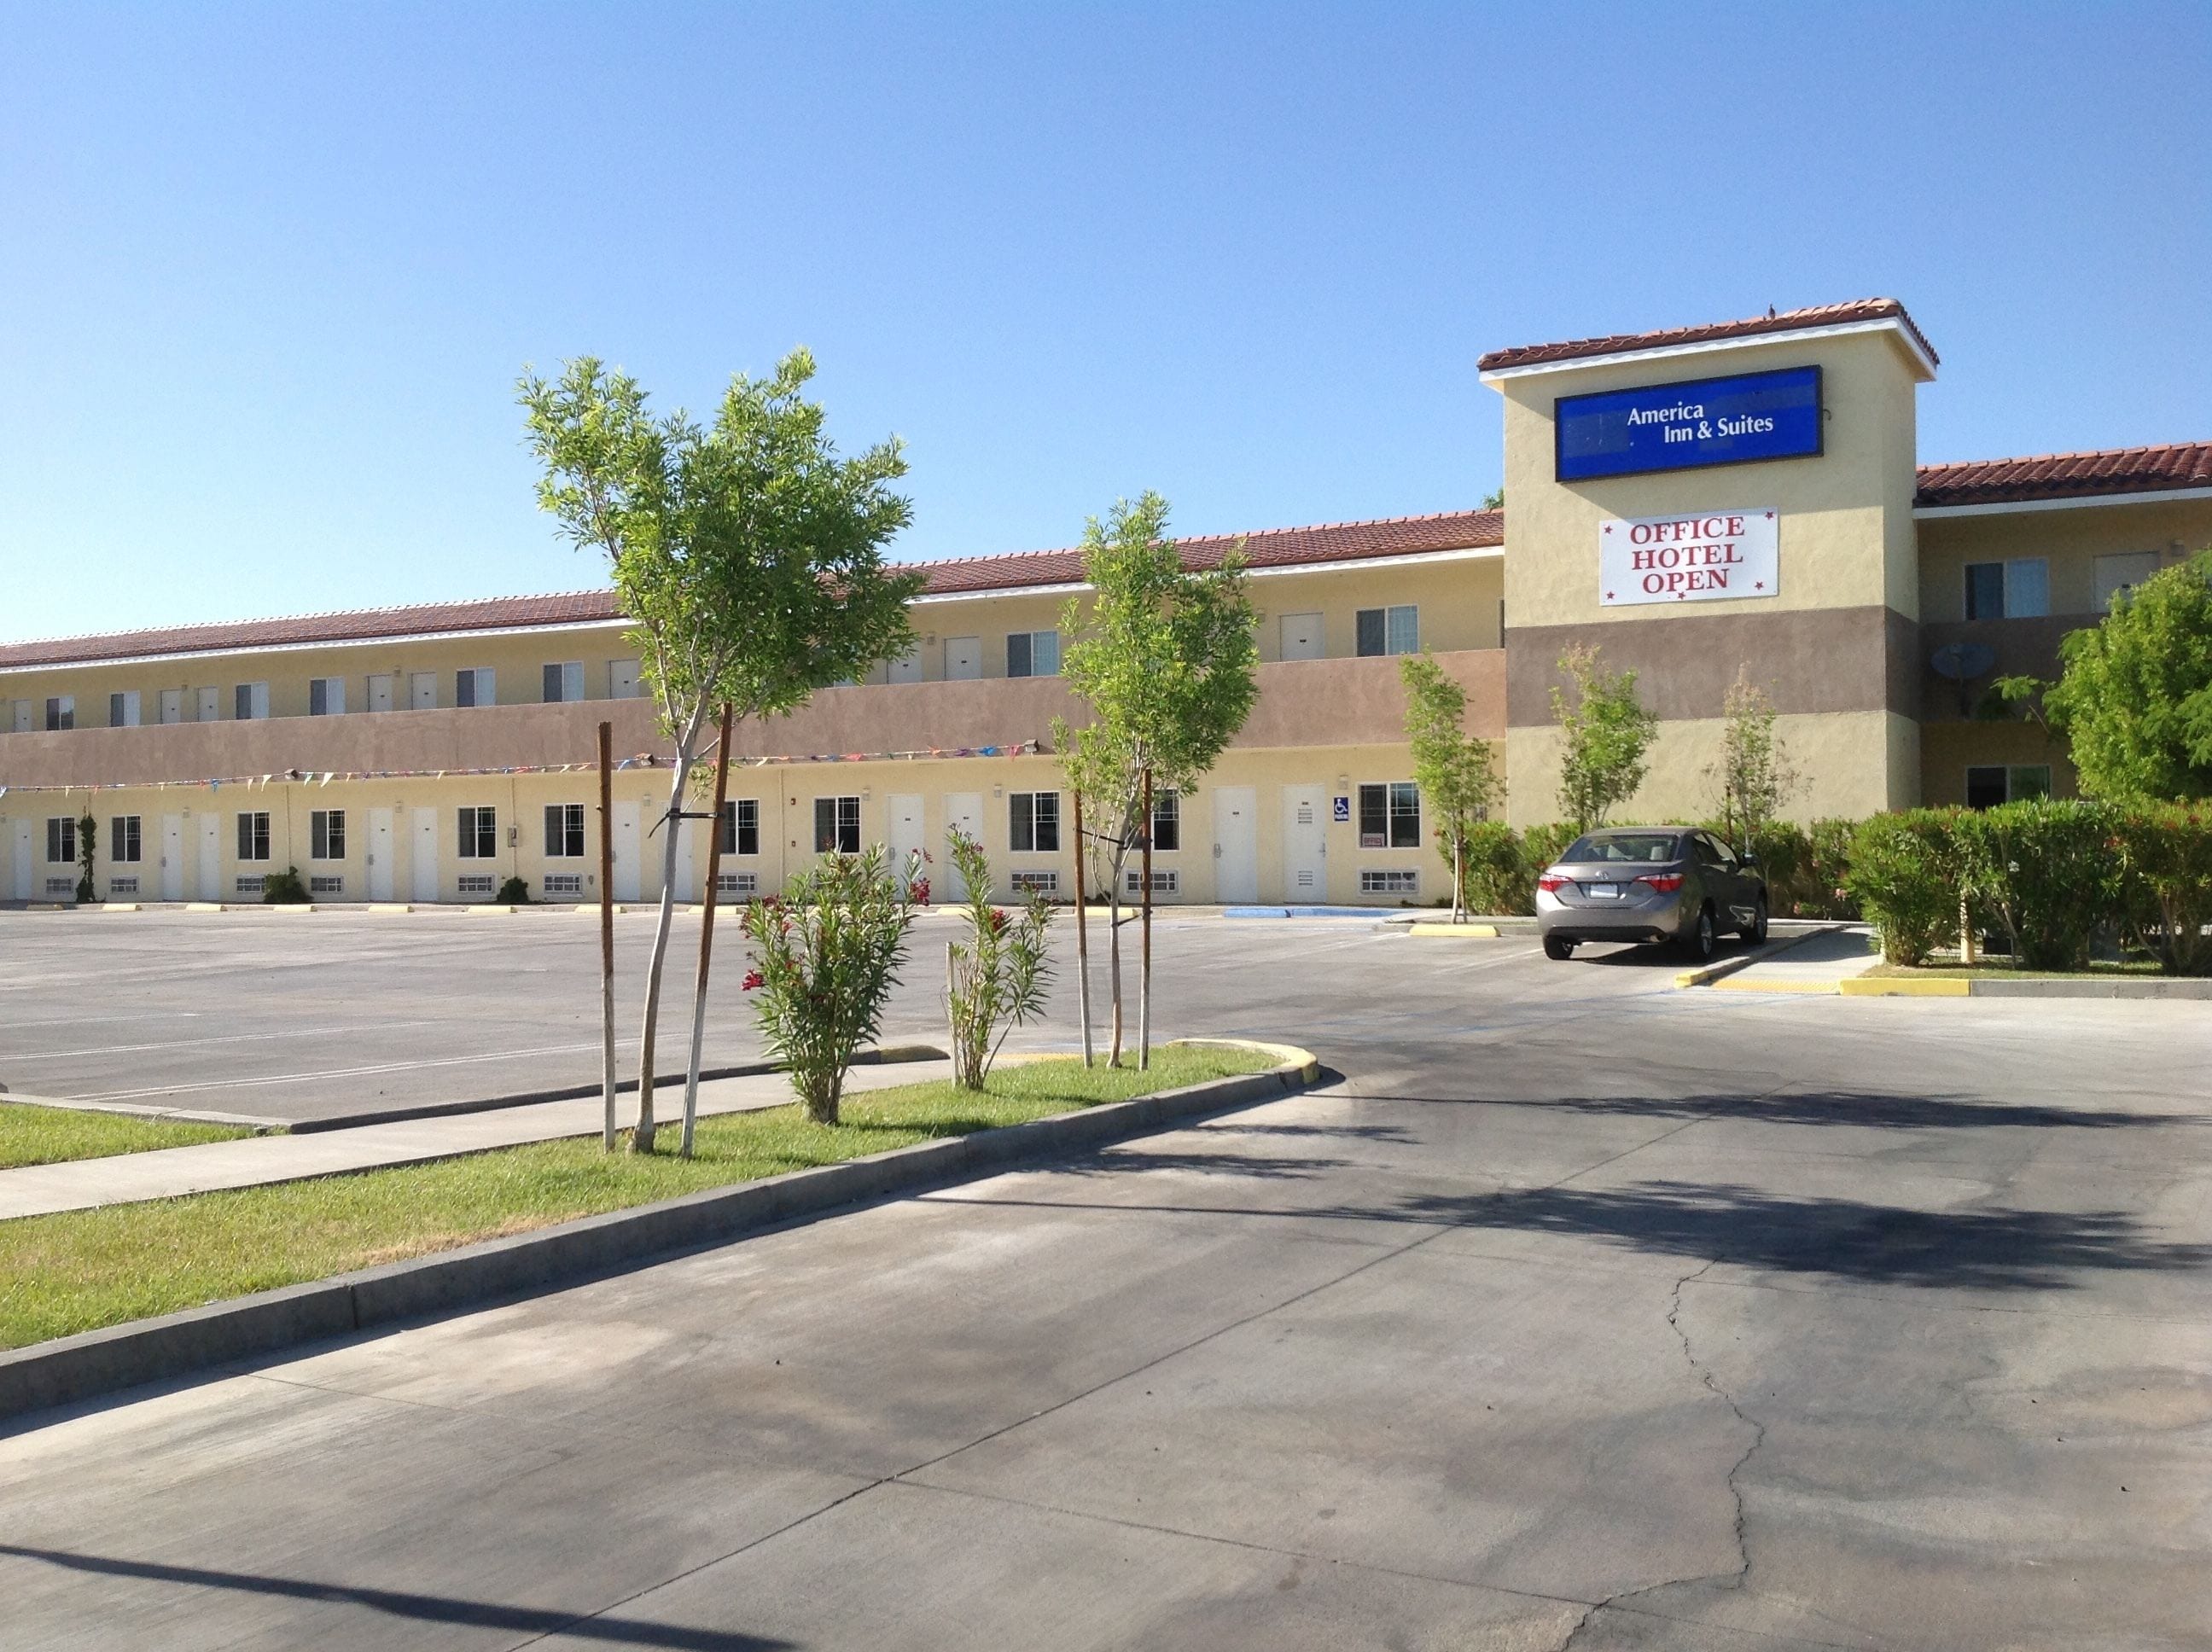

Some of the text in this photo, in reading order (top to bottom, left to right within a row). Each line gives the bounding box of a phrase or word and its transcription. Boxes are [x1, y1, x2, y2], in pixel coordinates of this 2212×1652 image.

[1627, 401, 1704, 426] America
[1664, 415, 1773, 443] Inn & Suites
[1630, 516, 1745, 544] OFFICE
[1632, 544, 1743, 570] HOTEL
[1643, 568, 1729, 594] OPEN
